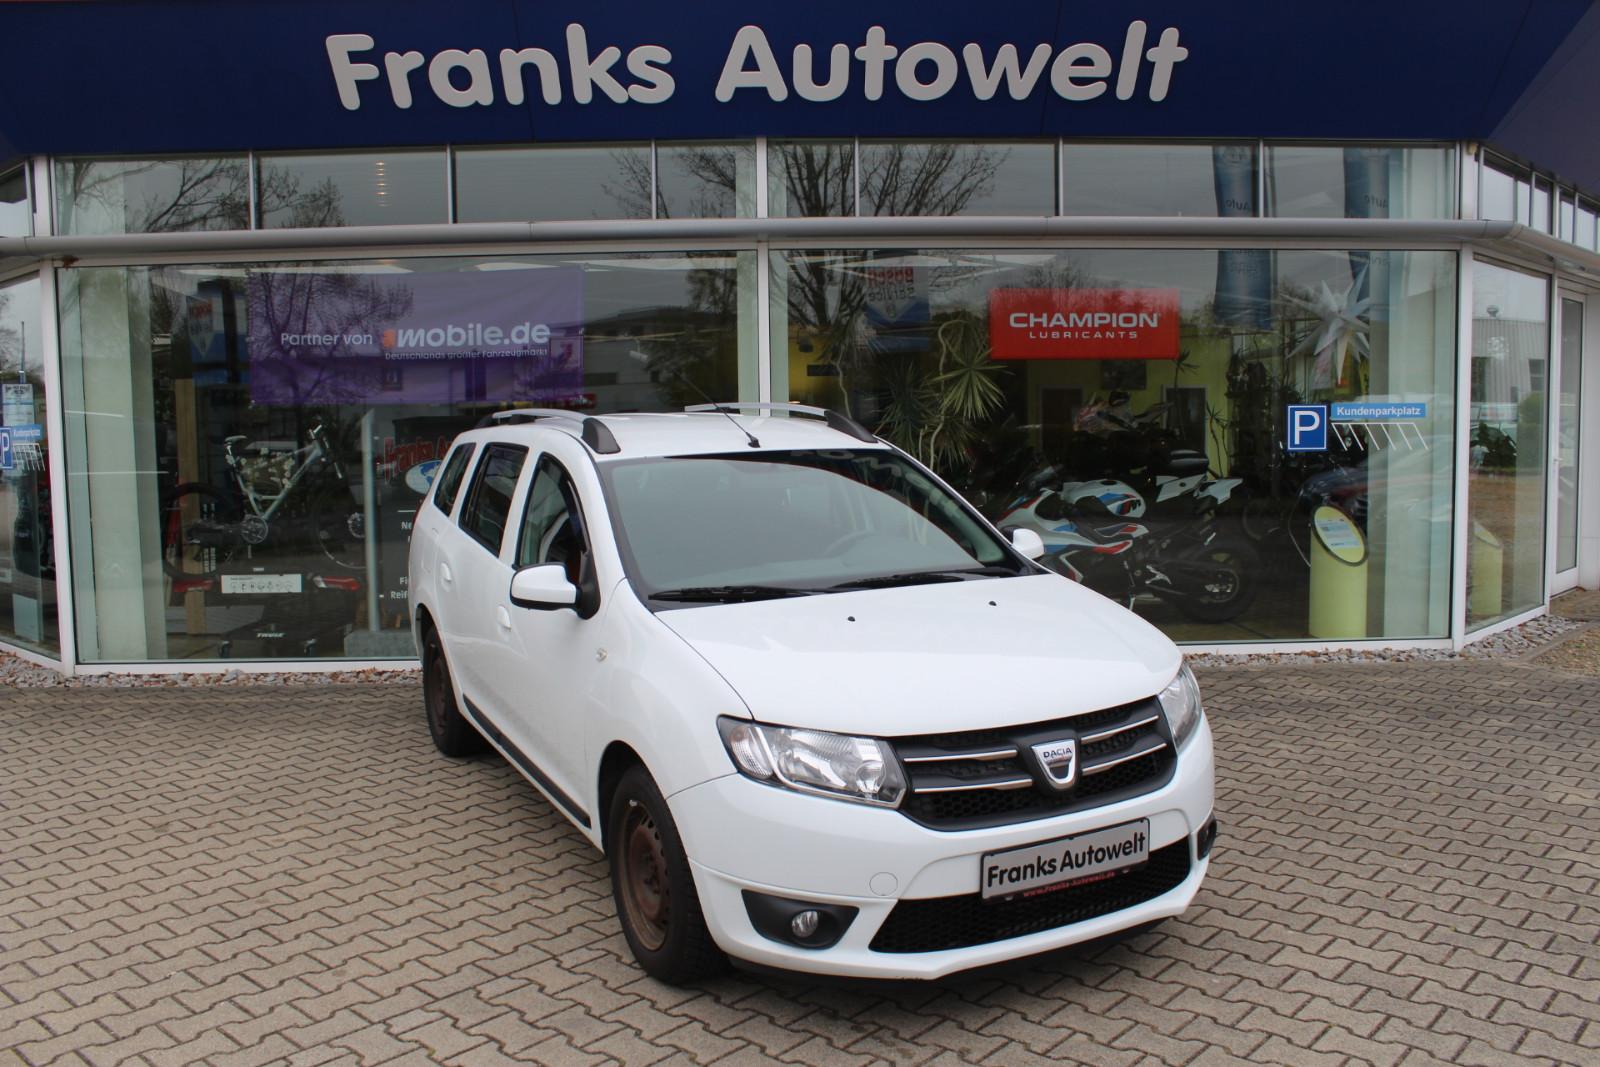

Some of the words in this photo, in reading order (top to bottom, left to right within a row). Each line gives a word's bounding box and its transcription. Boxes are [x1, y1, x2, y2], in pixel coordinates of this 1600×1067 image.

[325, 22, 676, 111] Franks
[714, 19, 1190, 104] Autowelt
[1009, 312, 1159, 328] CHAMPION
[280, 332, 341, 347] Partner
[343, 334, 374, 346] von
[1029, 331, 1139, 340] LUBRICANTS
[1336, 405, 1421, 418] Kundenparkplatz
[1043, 747, 1073, 759] DACIA
[987, 855, 1058, 889] Franks
[1059, 832, 1146, 874] Autowelt
